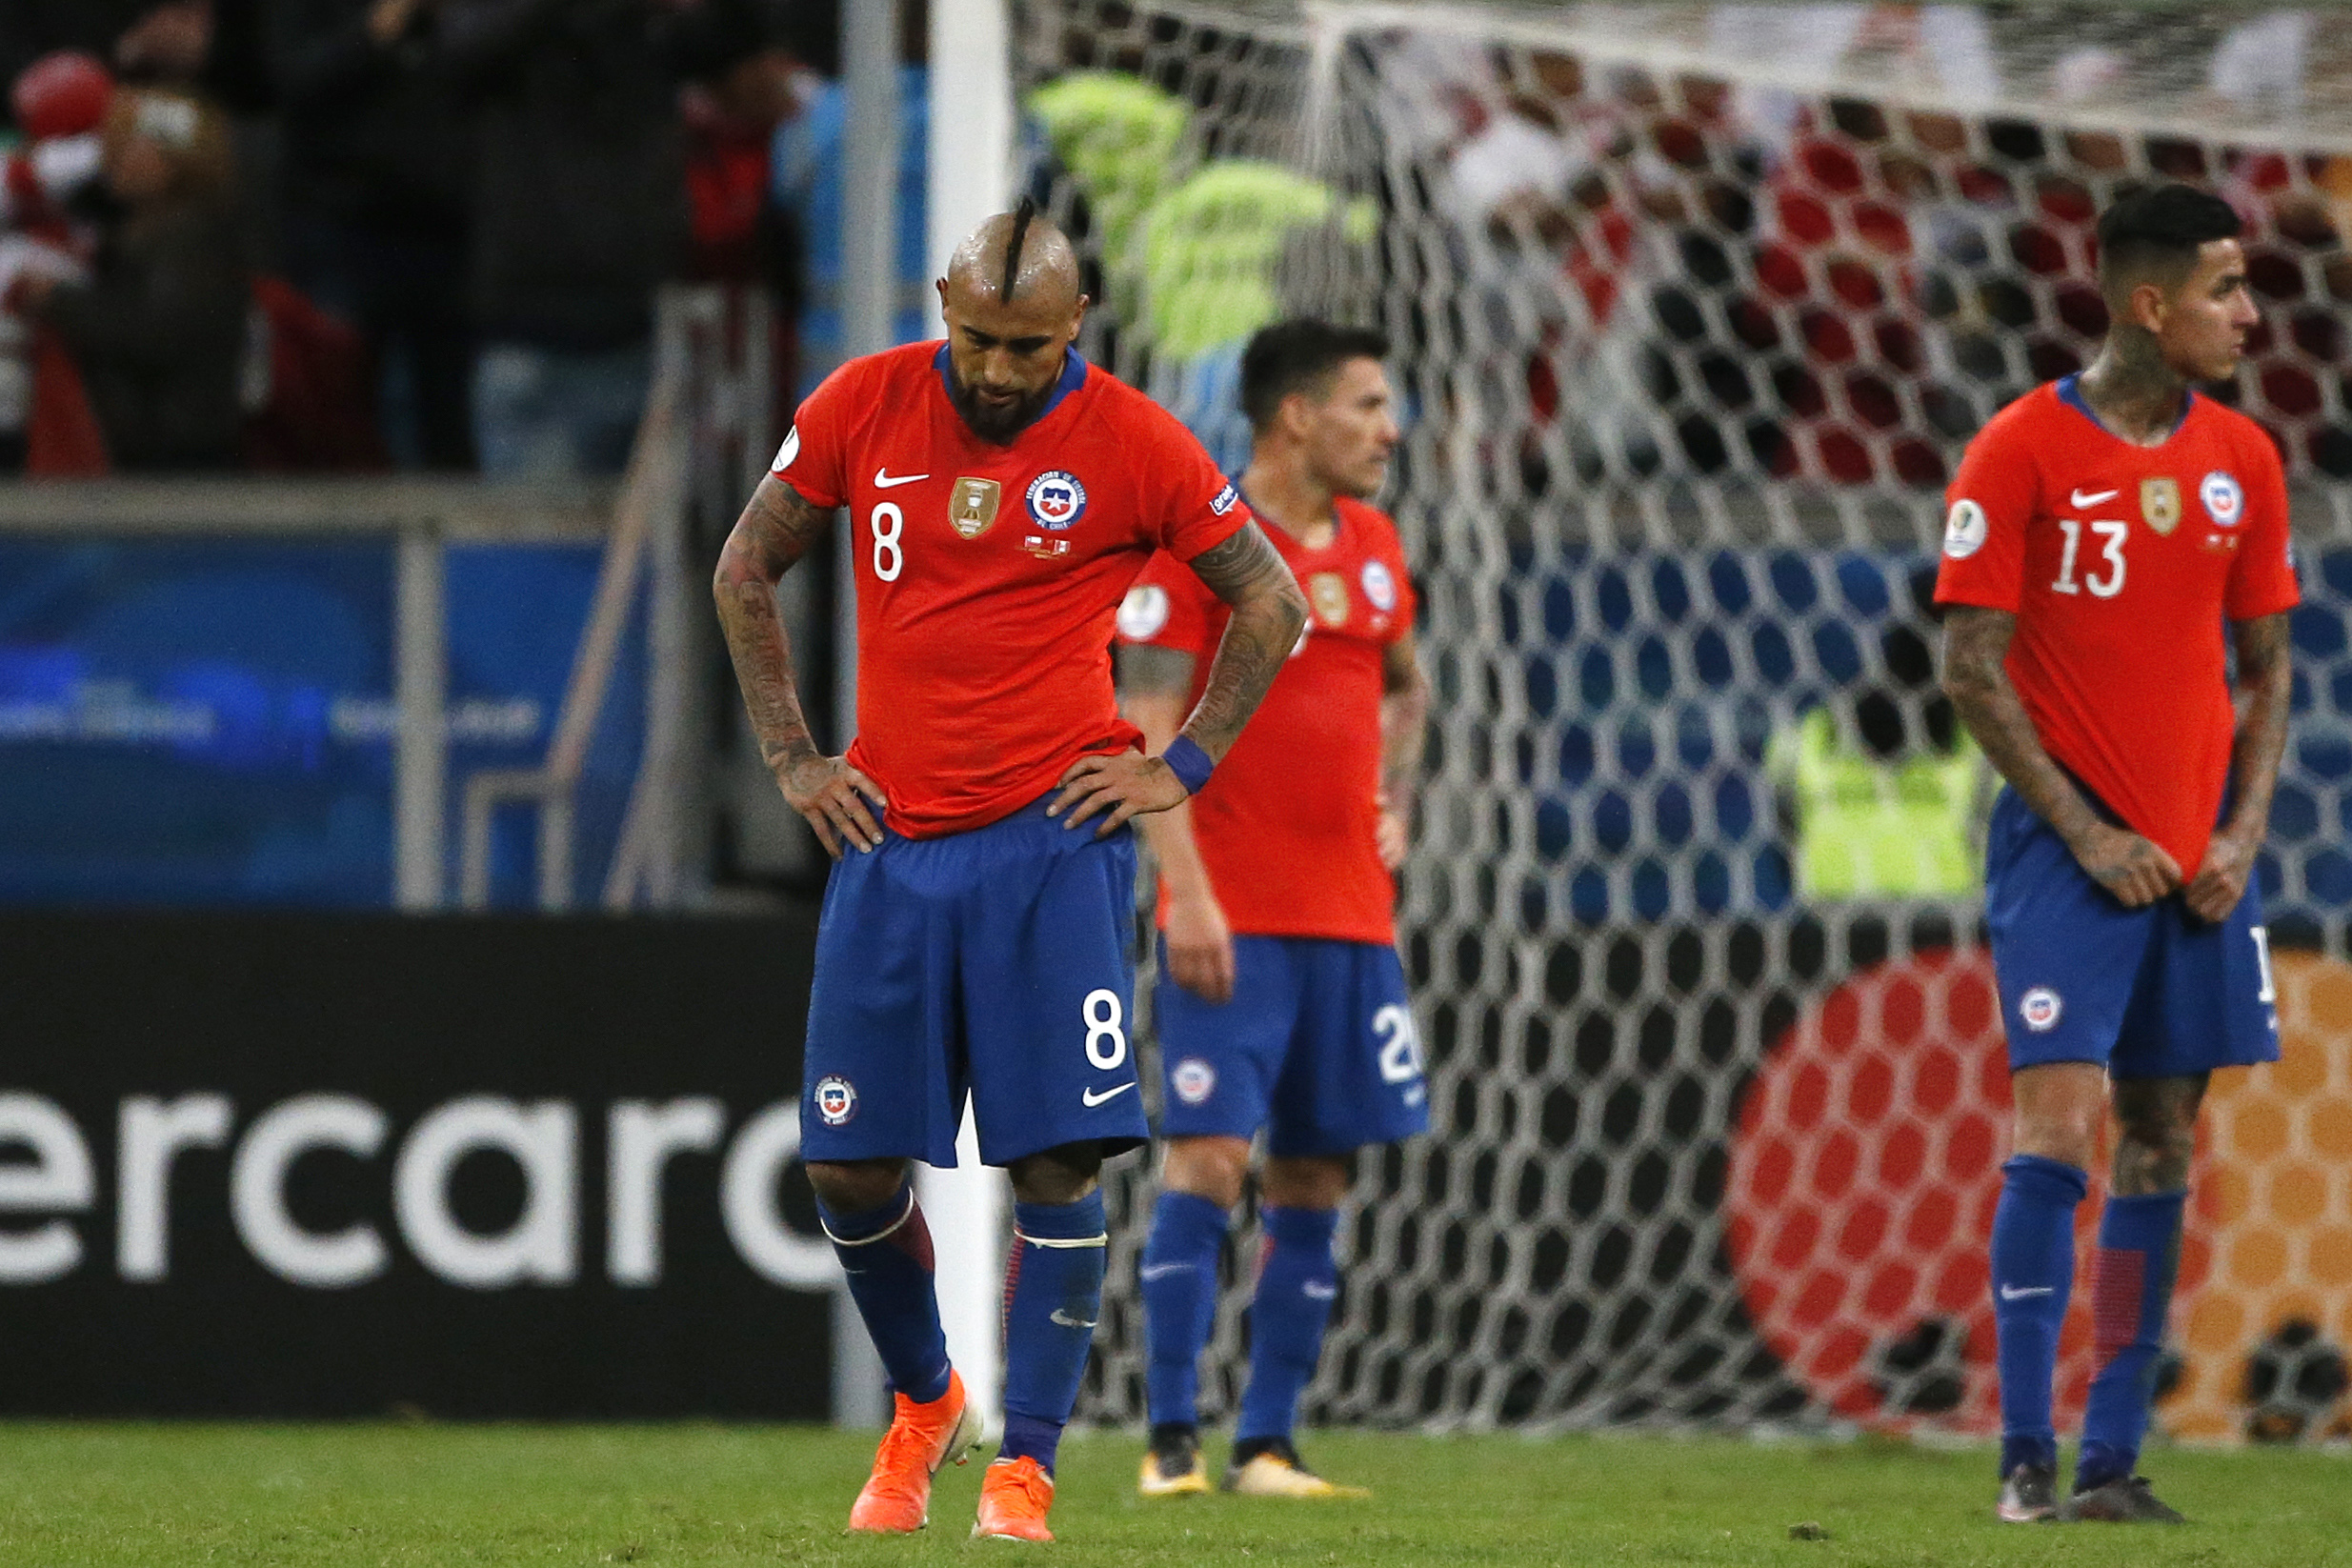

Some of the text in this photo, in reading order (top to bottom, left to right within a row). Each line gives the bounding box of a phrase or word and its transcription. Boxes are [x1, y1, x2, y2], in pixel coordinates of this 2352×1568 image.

[871, 501, 903, 582] 8
[2051, 519, 2128, 597] 13
[1082, 988, 1126, 1069] 8
